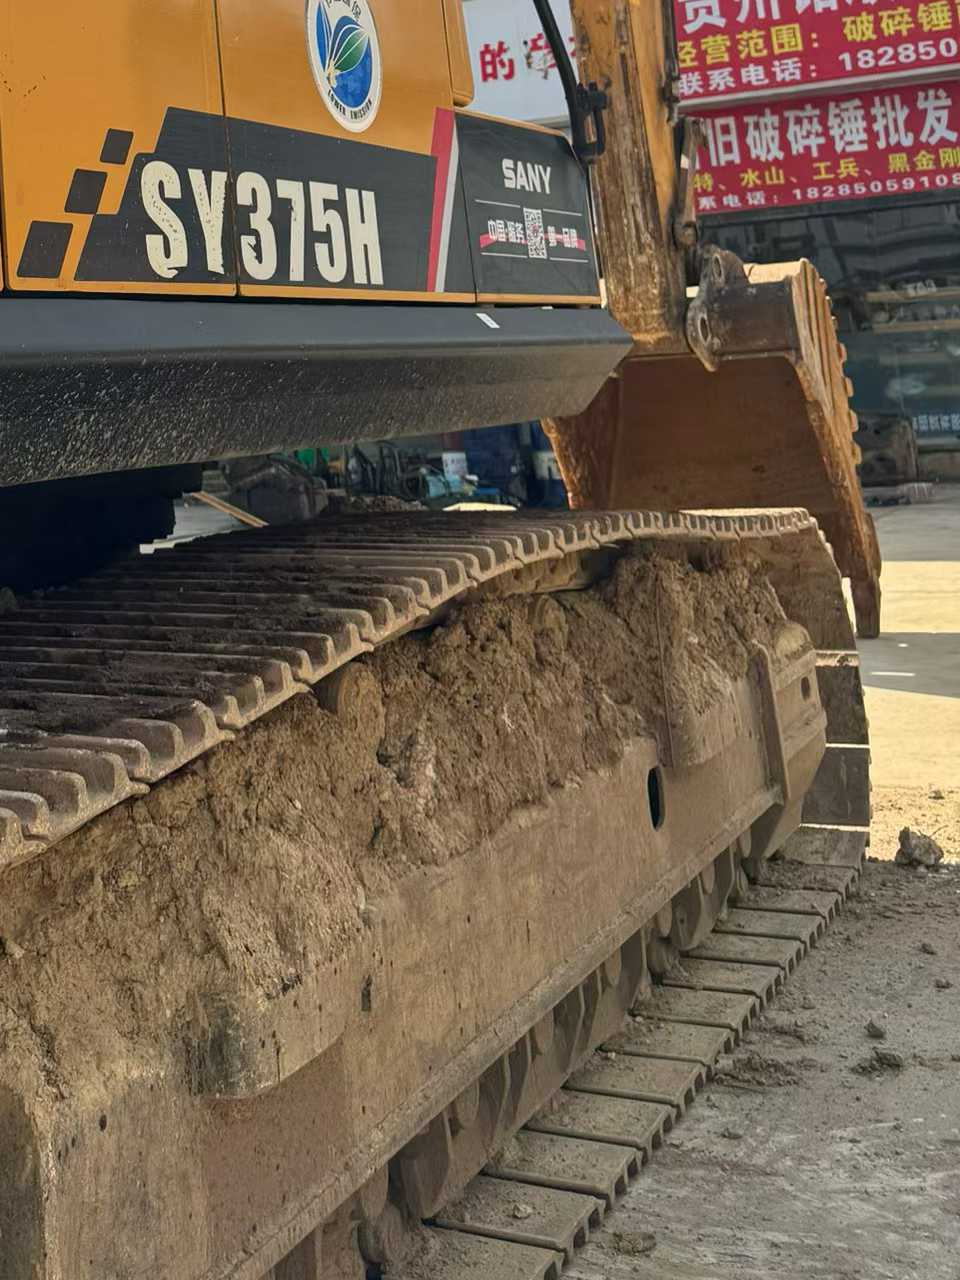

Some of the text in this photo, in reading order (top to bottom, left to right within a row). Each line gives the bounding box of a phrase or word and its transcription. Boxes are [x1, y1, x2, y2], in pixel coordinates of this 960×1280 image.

[693, 89, 958, 170] 旧破碎锤批发
[501, 158, 552, 194] SANY
[140, 160, 384, 286] SY375H
